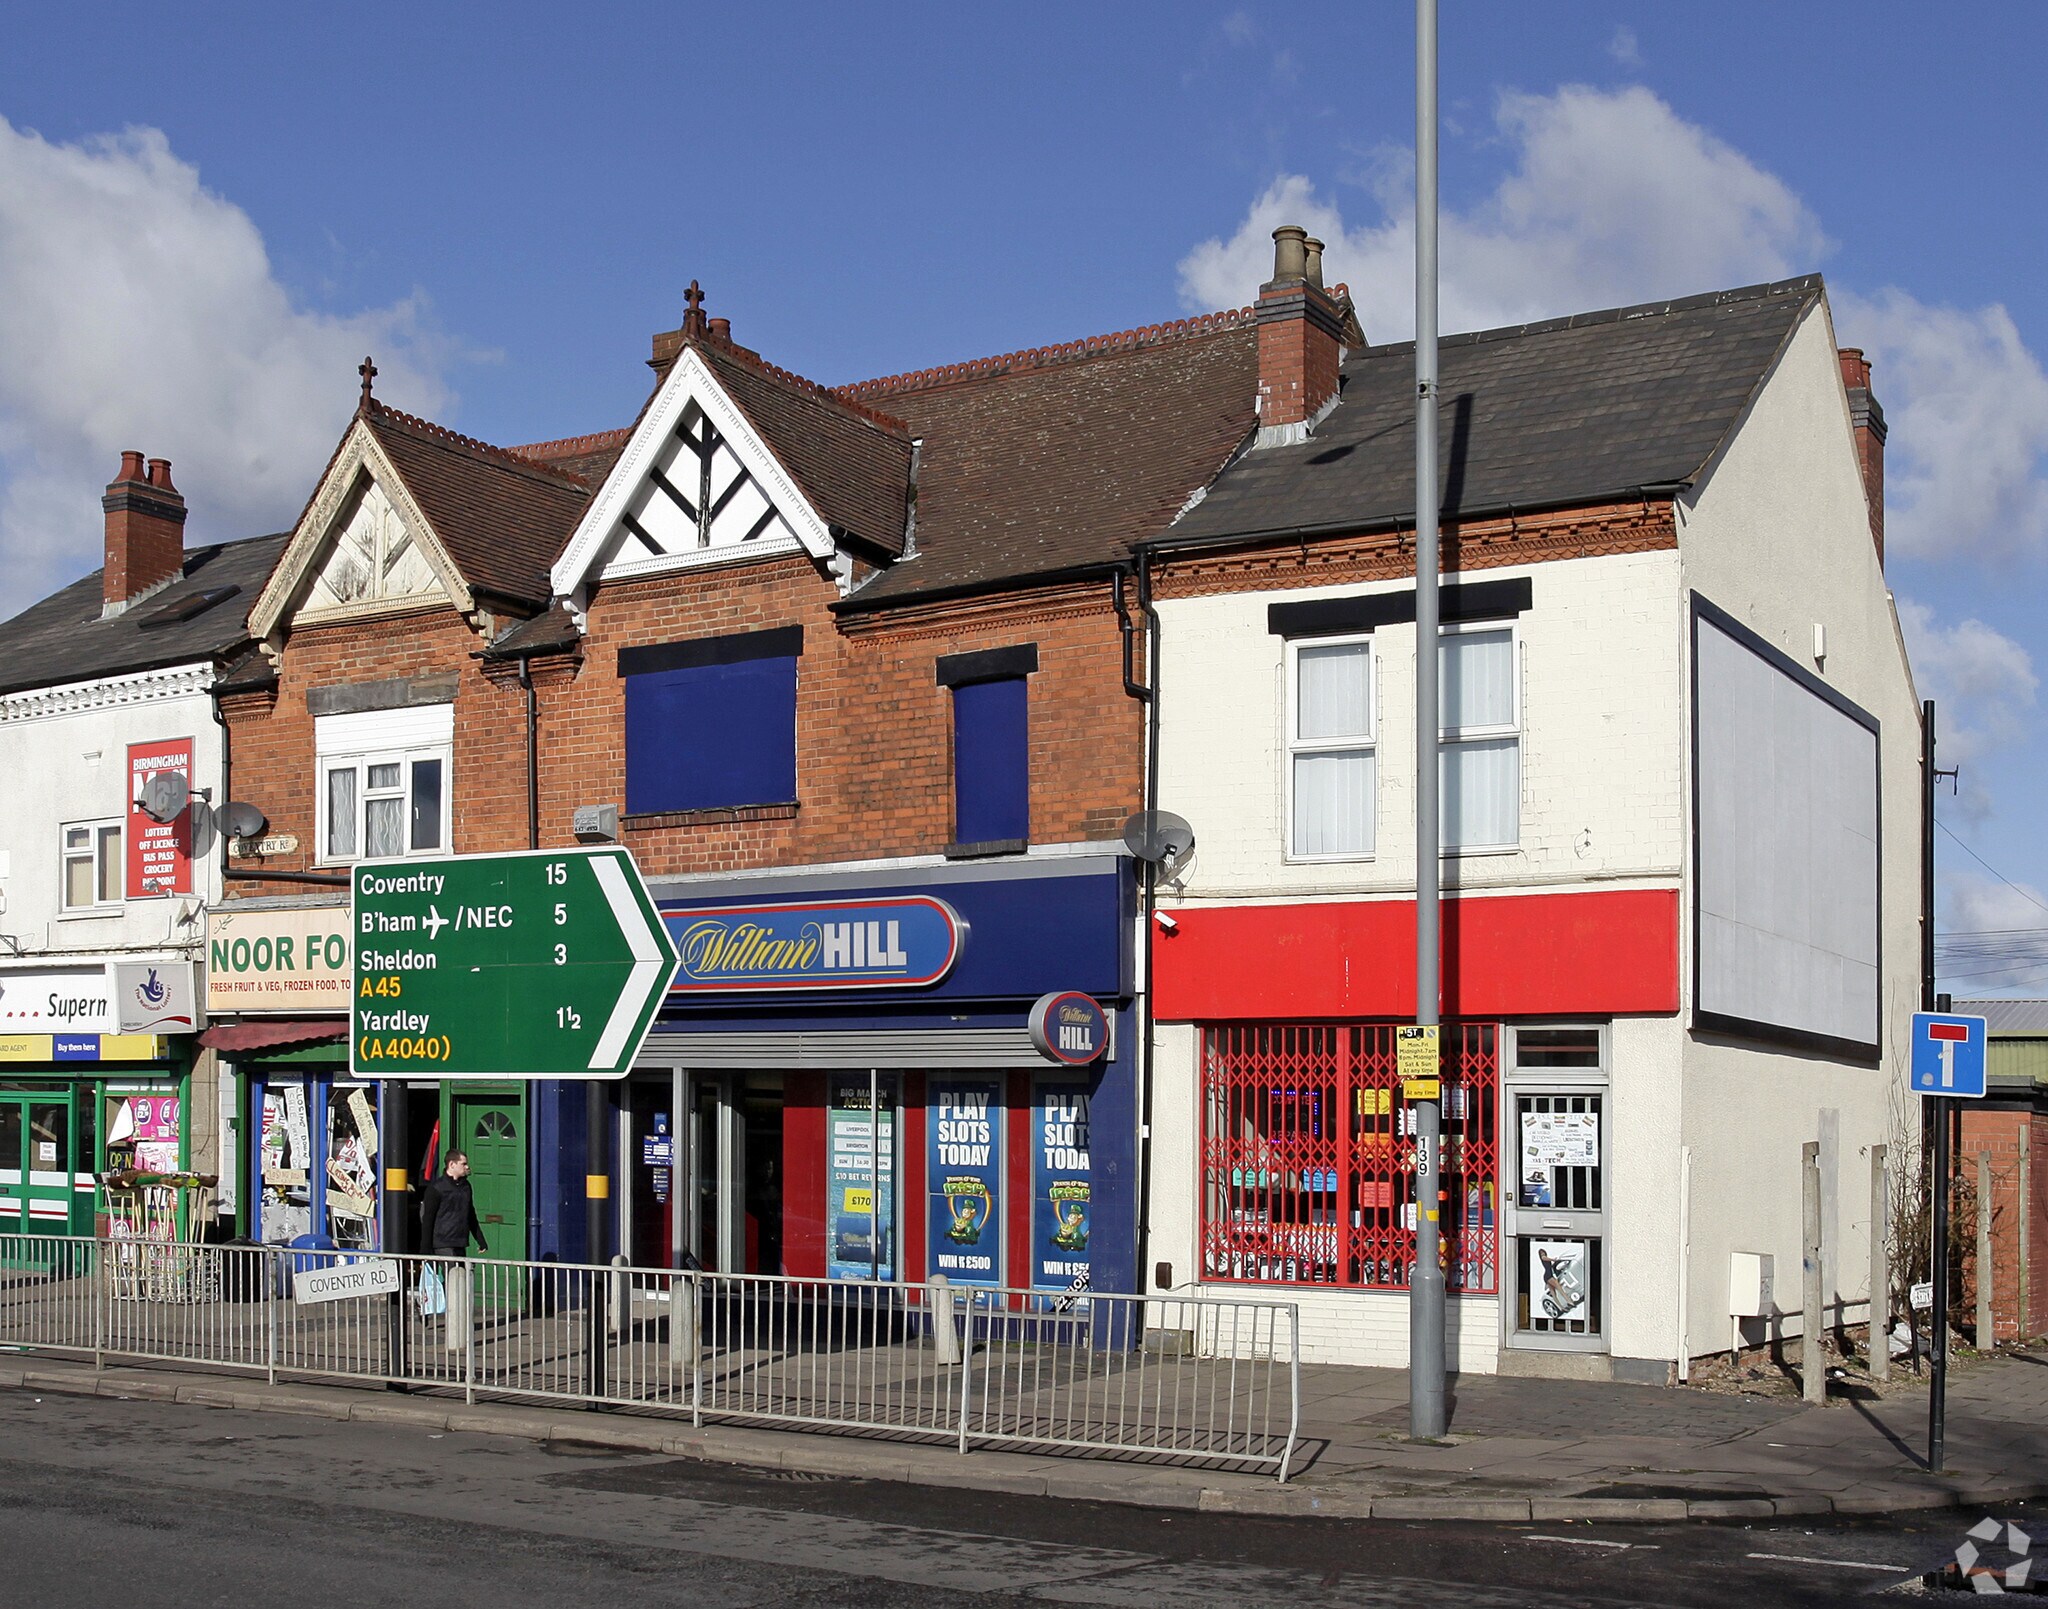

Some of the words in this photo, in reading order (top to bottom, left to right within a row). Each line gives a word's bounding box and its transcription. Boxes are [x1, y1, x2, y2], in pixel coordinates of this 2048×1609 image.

[133, 754, 188, 770] BIRMINGHAM
[144, 826, 174, 837] LOTTERY
[139, 840, 152, 850] OFF
[153, 839, 179, 849] LICENCE
[143, 853, 156, 862] BUS
[158, 851, 175, 861] PASS
[144, 864, 174, 874] GROCERY
[156, 876, 176, 886] POINT
[360, 870, 445, 896] Coventry
[546, 863, 567, 885] 15
[360, 912, 416, 934] B'ham
[554, 903, 567, 926] 5
[212, 936, 295, 972] NOOR
[306, 934, 351, 970] FO
[682, 920, 822, 974] William
[824, 920, 906, 968] HILL
[360, 949, 436, 972] Sheldon
[554, 944, 567, 966] 3
[210, 982, 232, 992] FRESH
[234, 982, 255, 992] FRUIT
[257, 982, 263, 991] &
[264, 981, 282, 993] VEG,
[284, 980, 314, 991] FROZEN
[316, 980, 338, 992] FOOD,
[139, 999, 162, 1010] National
[360, 1010, 430, 1034] Yardley
[1059, 1026, 1092, 1050] HILL
[1407, 1028, 1418, 1037] 5T
[58, 1043, 67, 1052] Buy
[840, 1088, 854, 1097] BIG
[856, 1089, 887, 1098] MACH
[939, 1092, 990, 1120] PLAY
[938, 1121, 990, 1143] SLOTS
[1044, 1124, 1090, 1146] SLOT
[110, 1152, 132, 1168] OPN
[938, 1144, 990, 1166] TODAY
[835, 1172, 847, 1180] £10
[861, 1174, 890, 1182] RETRNS
[852, 1196, 871, 1206] £170
[938, 1254, 958, 1268] WIN
[966, 1255, 991, 1270] £500
[1043, 1261, 1064, 1274] WIN
[1072, 1262, 1089, 1276] £5
[310, 1273, 365, 1293] COVENTRY
[371, 1270, 387, 1285] RD
